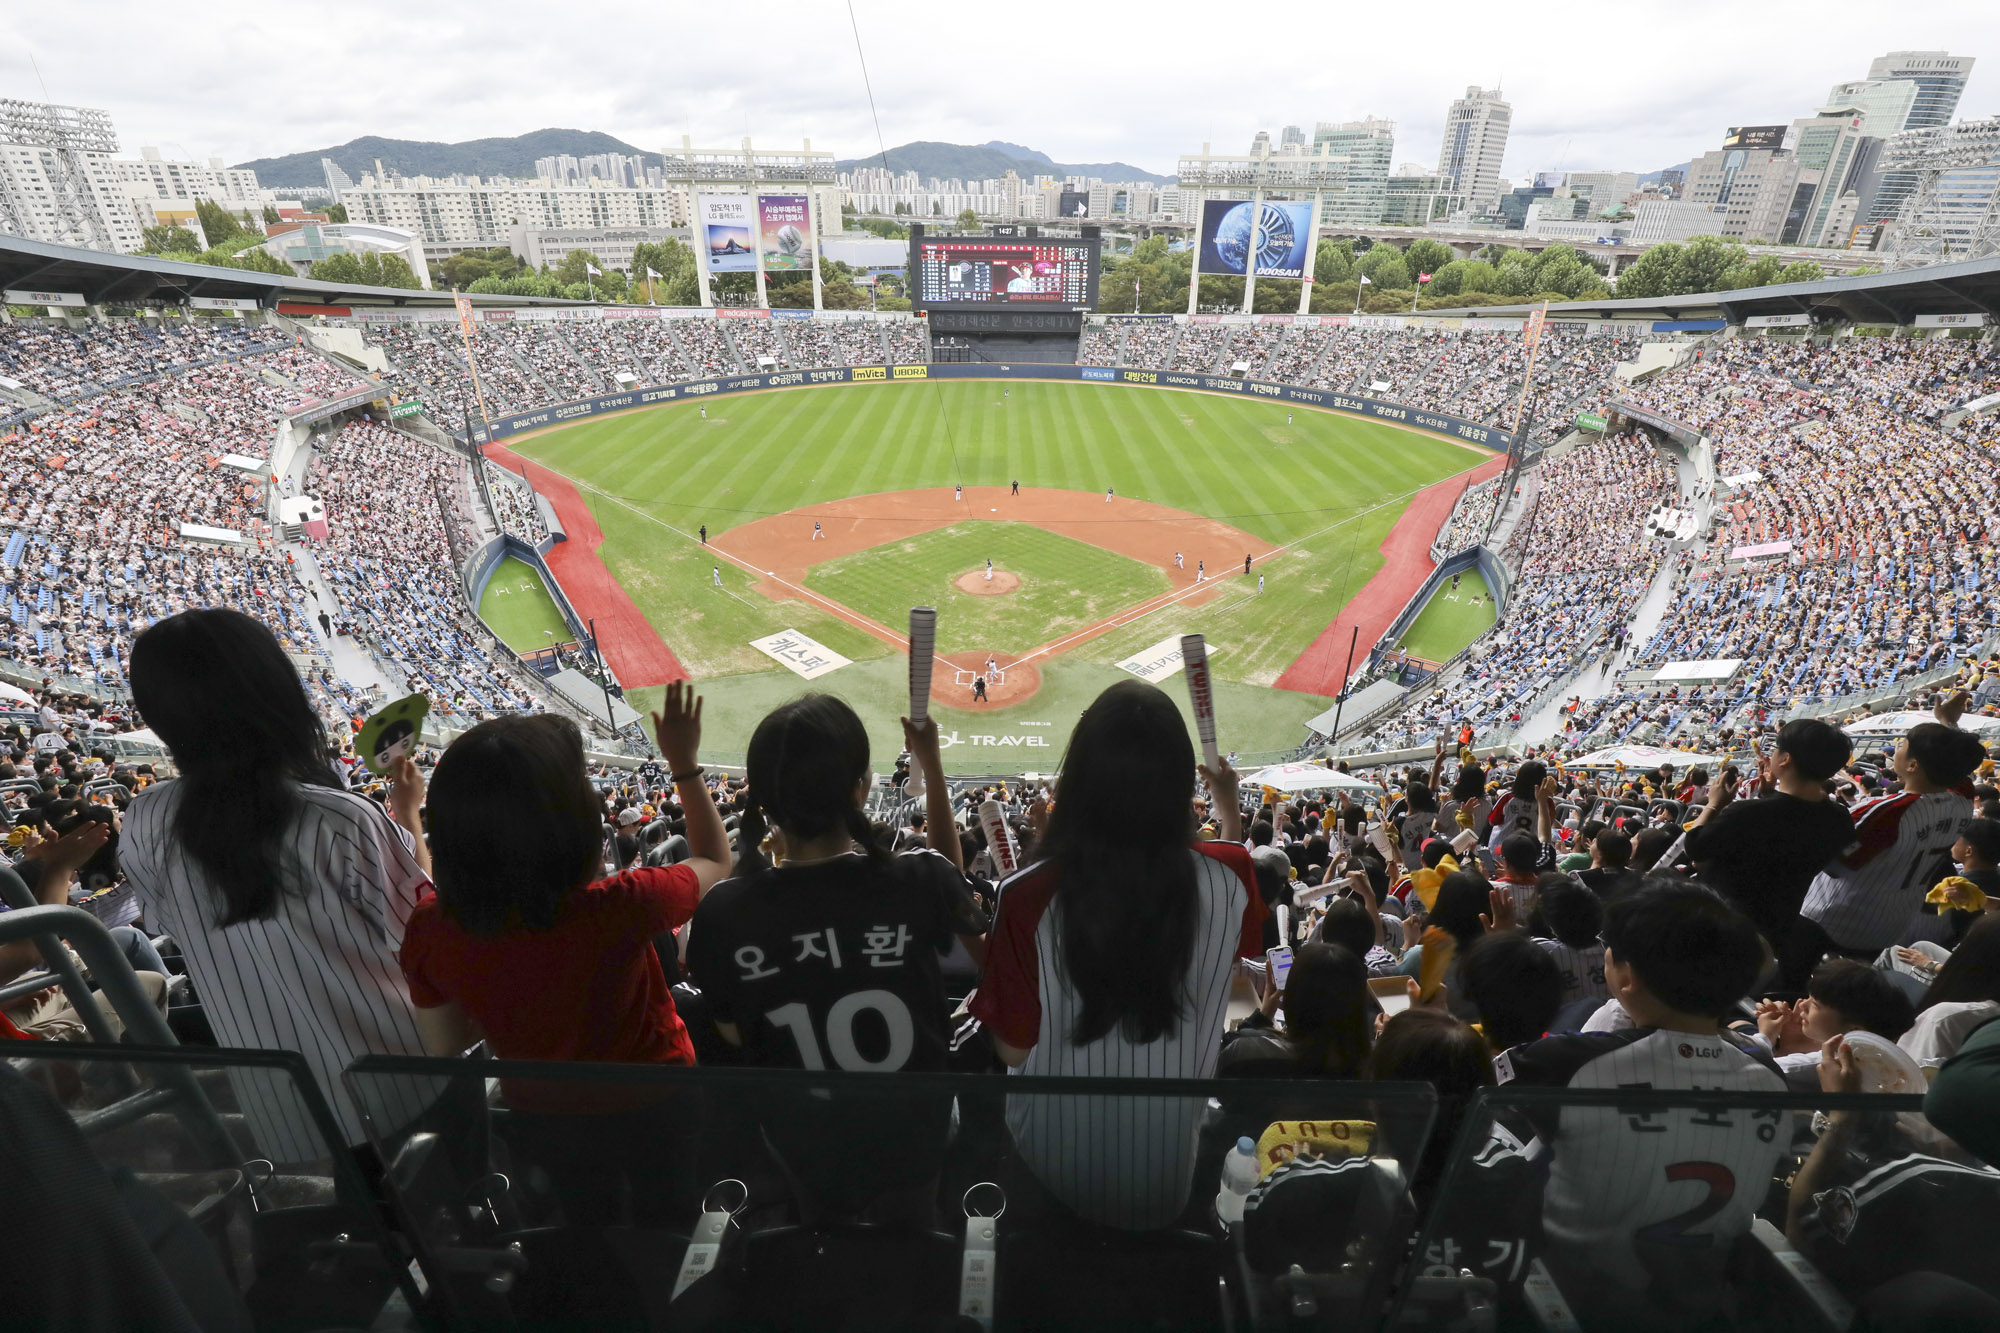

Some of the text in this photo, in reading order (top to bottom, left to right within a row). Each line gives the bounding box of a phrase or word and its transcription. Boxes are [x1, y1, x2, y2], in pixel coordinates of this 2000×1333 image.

[1905, 60, 1960, 68] GLASS TOWER
[731, 203, 742, 212] 1위
[998, 227, 1012, 235] 14:27
[1256, 267, 1301, 277] DOOSAN
[723, 309, 748, 318] redcap
[934, 315, 1000, 327] 한국경제신문
[1012, 315, 1075, 328] 한국경제TV
[810, 370, 845, 382] 현대해상
[852, 368, 886, 379] I'mVita
[893, 367, 926, 377] UBORA
[1124, 371, 1157, 383] 대방건설
[1166, 375, 1198, 386] HANCOM
[512, 419, 531, 429] BNK
[1458, 425, 1488, 442] 키움증권
[768, 638, 831, 672] 캐스퍼
[1135, 648, 1184, 677] 메디카코
[970, 735, 1050, 747] TRAVEL
[734, 924, 913, 981] 오지환
[763, 989, 915, 1073] 10
